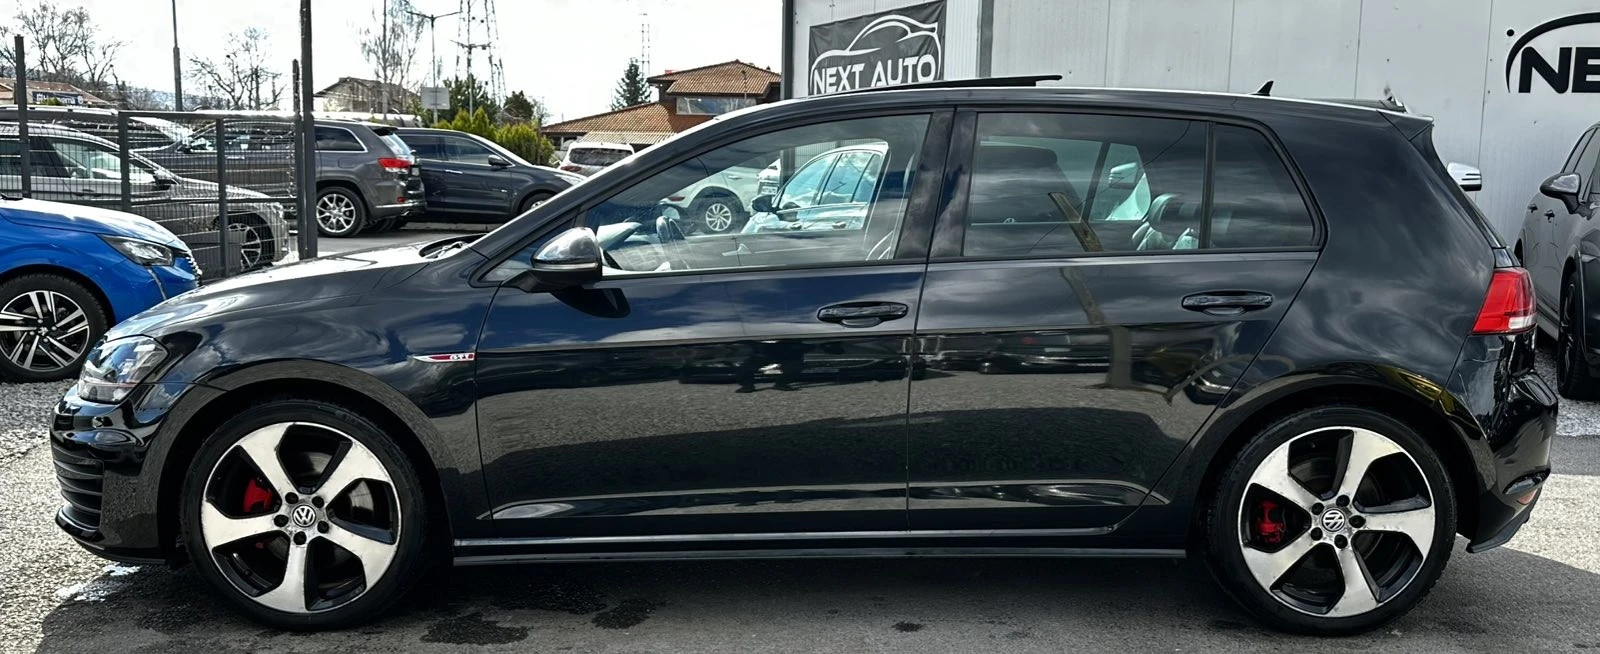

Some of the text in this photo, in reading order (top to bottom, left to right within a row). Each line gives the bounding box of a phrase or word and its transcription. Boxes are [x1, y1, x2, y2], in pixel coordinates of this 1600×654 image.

[813, 54, 936, 95] NEXT AUTO
[294, 505, 315, 526] VW
